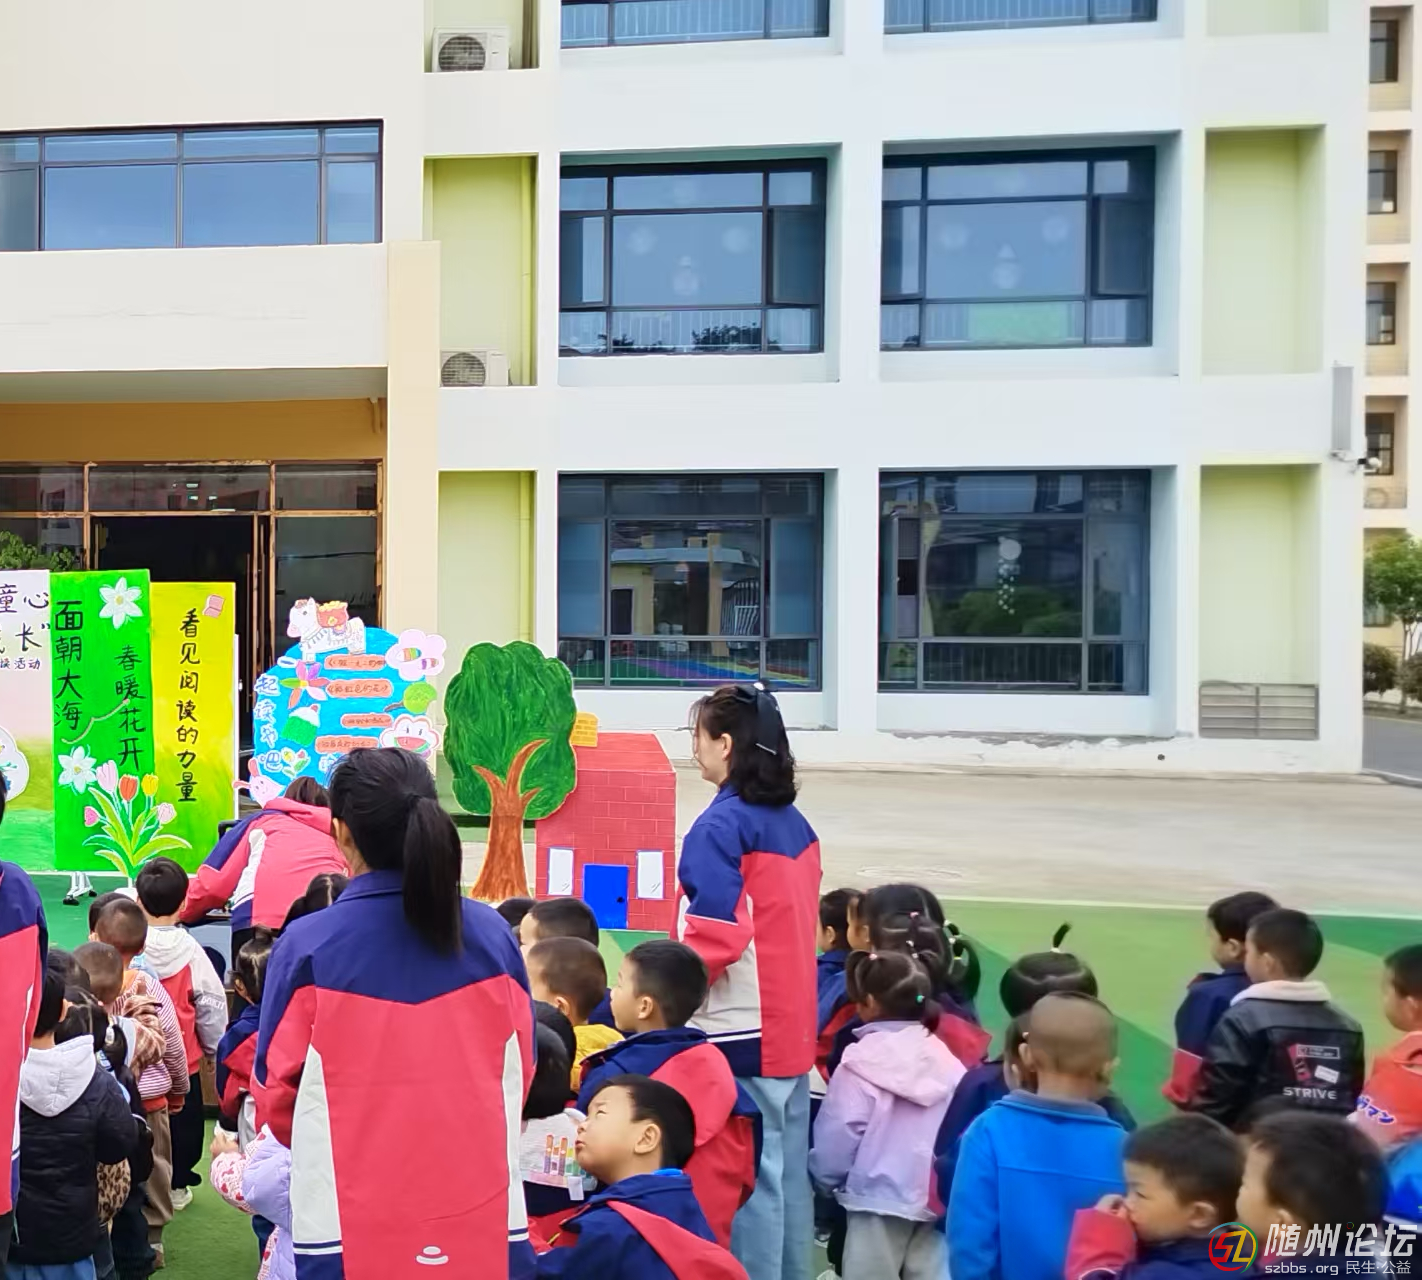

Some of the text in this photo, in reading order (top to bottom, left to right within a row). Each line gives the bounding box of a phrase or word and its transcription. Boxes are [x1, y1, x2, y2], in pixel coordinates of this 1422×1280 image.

[54, 600, 83, 731] 面朝大海
[115, 645, 146, 772] 春暖花开
[175, 607, 201, 802] 看见阅读的力量
[1282, 1086, 1338, 1100] STRIVE
